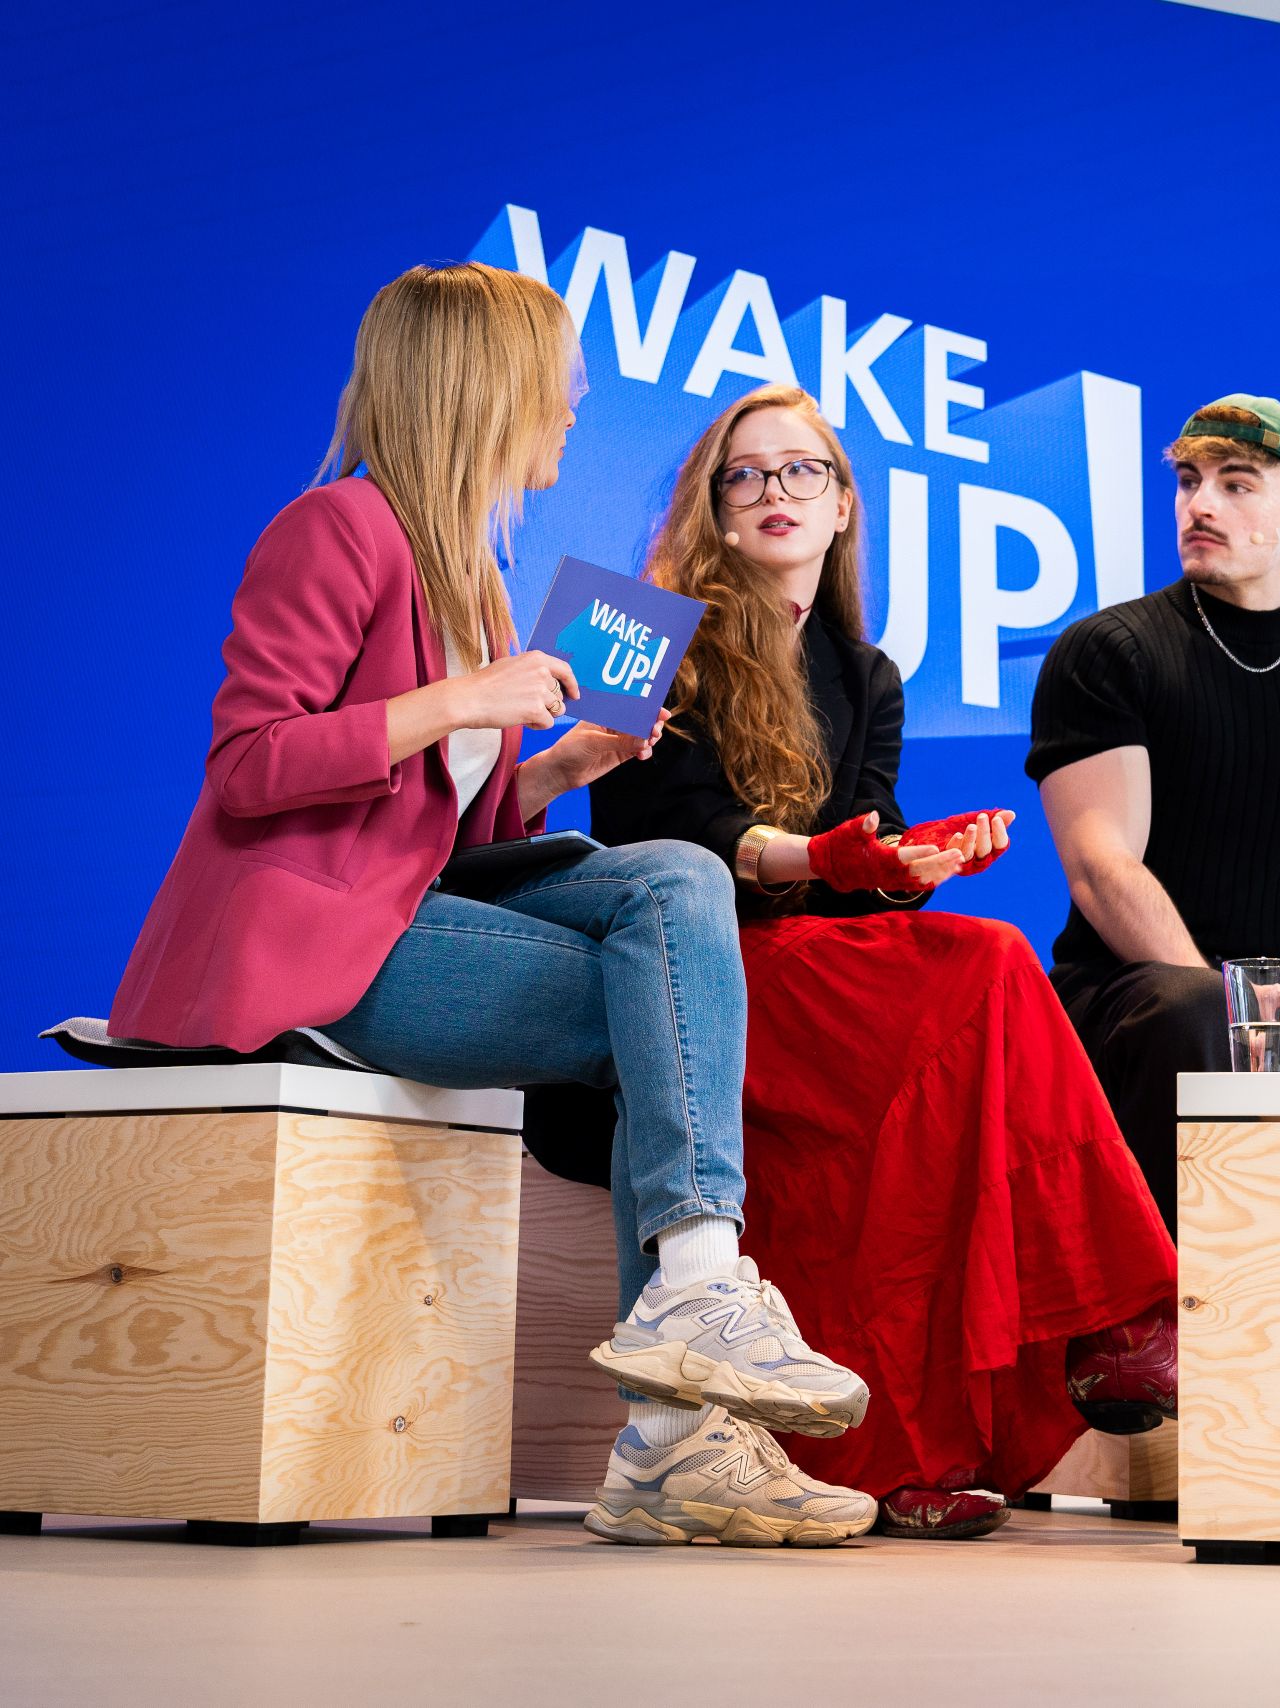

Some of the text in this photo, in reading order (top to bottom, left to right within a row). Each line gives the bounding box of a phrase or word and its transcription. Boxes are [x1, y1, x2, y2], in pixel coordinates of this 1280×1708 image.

[506, 203, 990, 464] WAKE
[589, 598, 653, 651] WAKE
[601, 635, 671, 698] UP!
